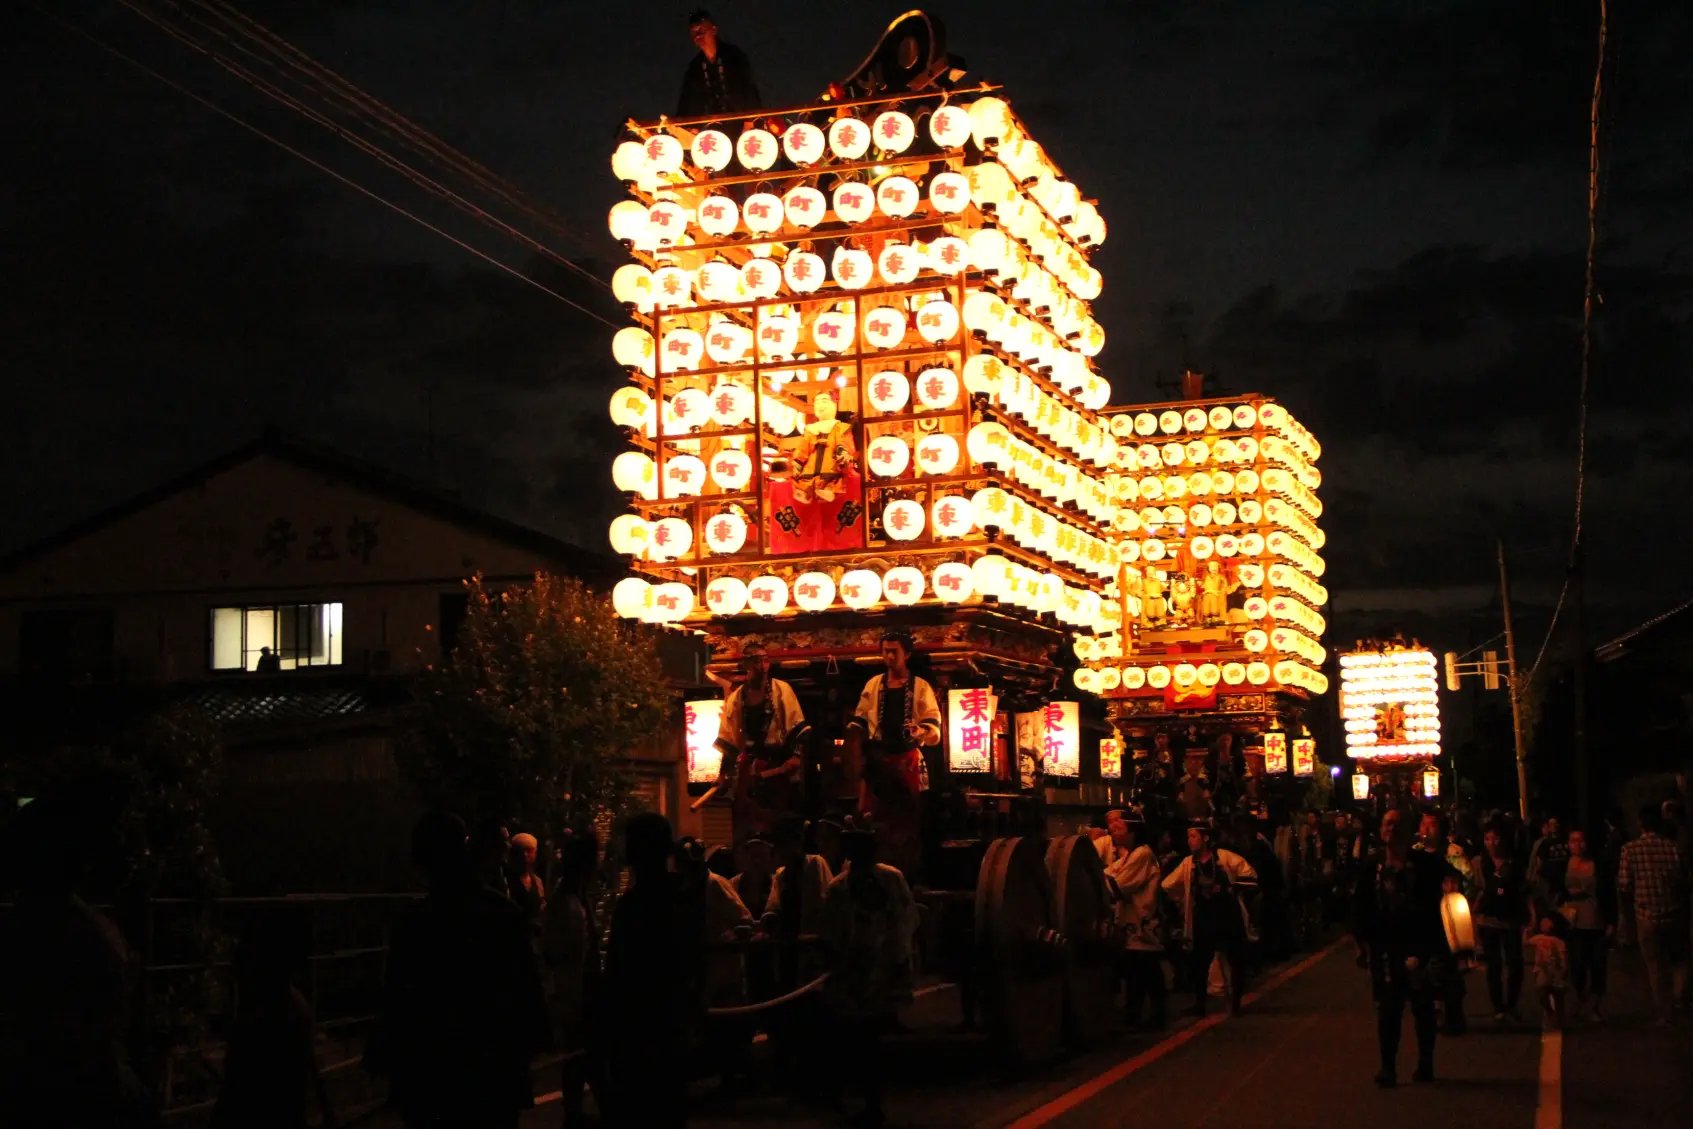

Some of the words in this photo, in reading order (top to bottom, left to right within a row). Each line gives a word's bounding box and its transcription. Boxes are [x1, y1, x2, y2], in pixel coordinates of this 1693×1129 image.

[882, 117, 901, 138] 東
[934, 113, 950, 135] 東
[699, 134, 717, 155] 東
[744, 136, 762, 158] 東
[789, 128, 807, 150] 東
[838, 125, 856, 148] 東
[647, 139, 664, 160] 東
[840, 192, 863, 209] 町
[883, 187, 905, 202] 町
[935, 183, 958, 199] 町
[703, 204, 725, 219] 町
[748, 203, 770, 218] 町
[790, 196, 813, 211] 町
[650, 210, 672, 226] 町
[886, 253, 904, 274] 東
[942, 244, 958, 264] 東
[746, 267, 764, 288] 東
[793, 258, 810, 281] 東
[839, 259, 856, 280] 東
[664, 273, 681, 295] 東
[818, 322, 841, 338] 町
[869, 320, 892, 336] 町
[921, 313, 944, 326] 町
[711, 333, 733, 350] 町
[762, 327, 784, 342] 町
[668, 339, 691, 355] 町
[875, 379, 893, 401] 東
[925, 377, 945, 400] 東
[674, 397, 690, 418] 東
[716, 393, 734, 415] 東
[872, 447, 895, 464] 町
[921, 448, 941, 462] 町
[670, 467, 691, 482] 町
[716, 461, 739, 476] 町
[986, 491, 1007, 512] 東
[891, 507, 909, 530] 東
[939, 503, 957, 527] 東
[655, 524, 671, 546] 東
[714, 520, 732, 542] 東
[798, 583, 820, 598] 町
[888, 578, 912, 594] 町
[939, 574, 962, 590] 町
[658, 594, 679, 610] 町
[752, 588, 774, 602] 町
[959, 689, 989, 759] 東町
[1043, 703, 1065, 764] 東町
[1101, 740, 1118, 773] 中町
[1266, 735, 1283, 768] 中町
[1297, 741, 1313, 771] 中町
